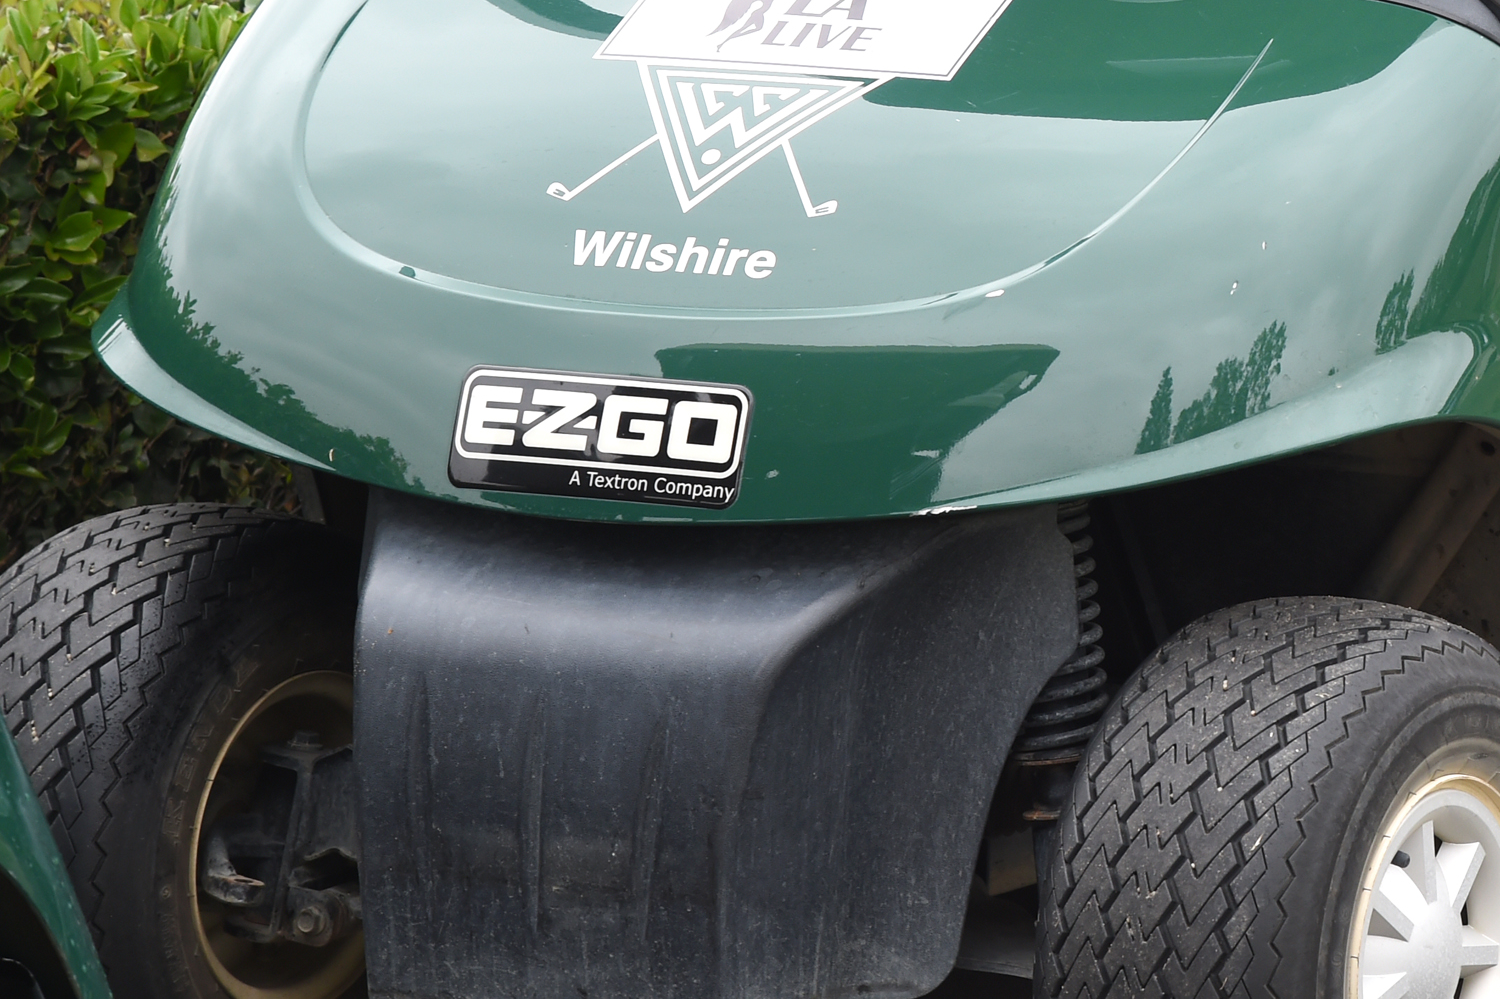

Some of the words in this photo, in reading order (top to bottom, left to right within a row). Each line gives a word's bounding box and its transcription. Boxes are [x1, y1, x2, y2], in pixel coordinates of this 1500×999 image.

[760, 20, 882, 52] LIVE
[572, 229, 777, 279] Wilshire
[568, 470, 581, 486] A
[586, 470, 648, 492] Textron
[653, 477, 735, 503] Company
